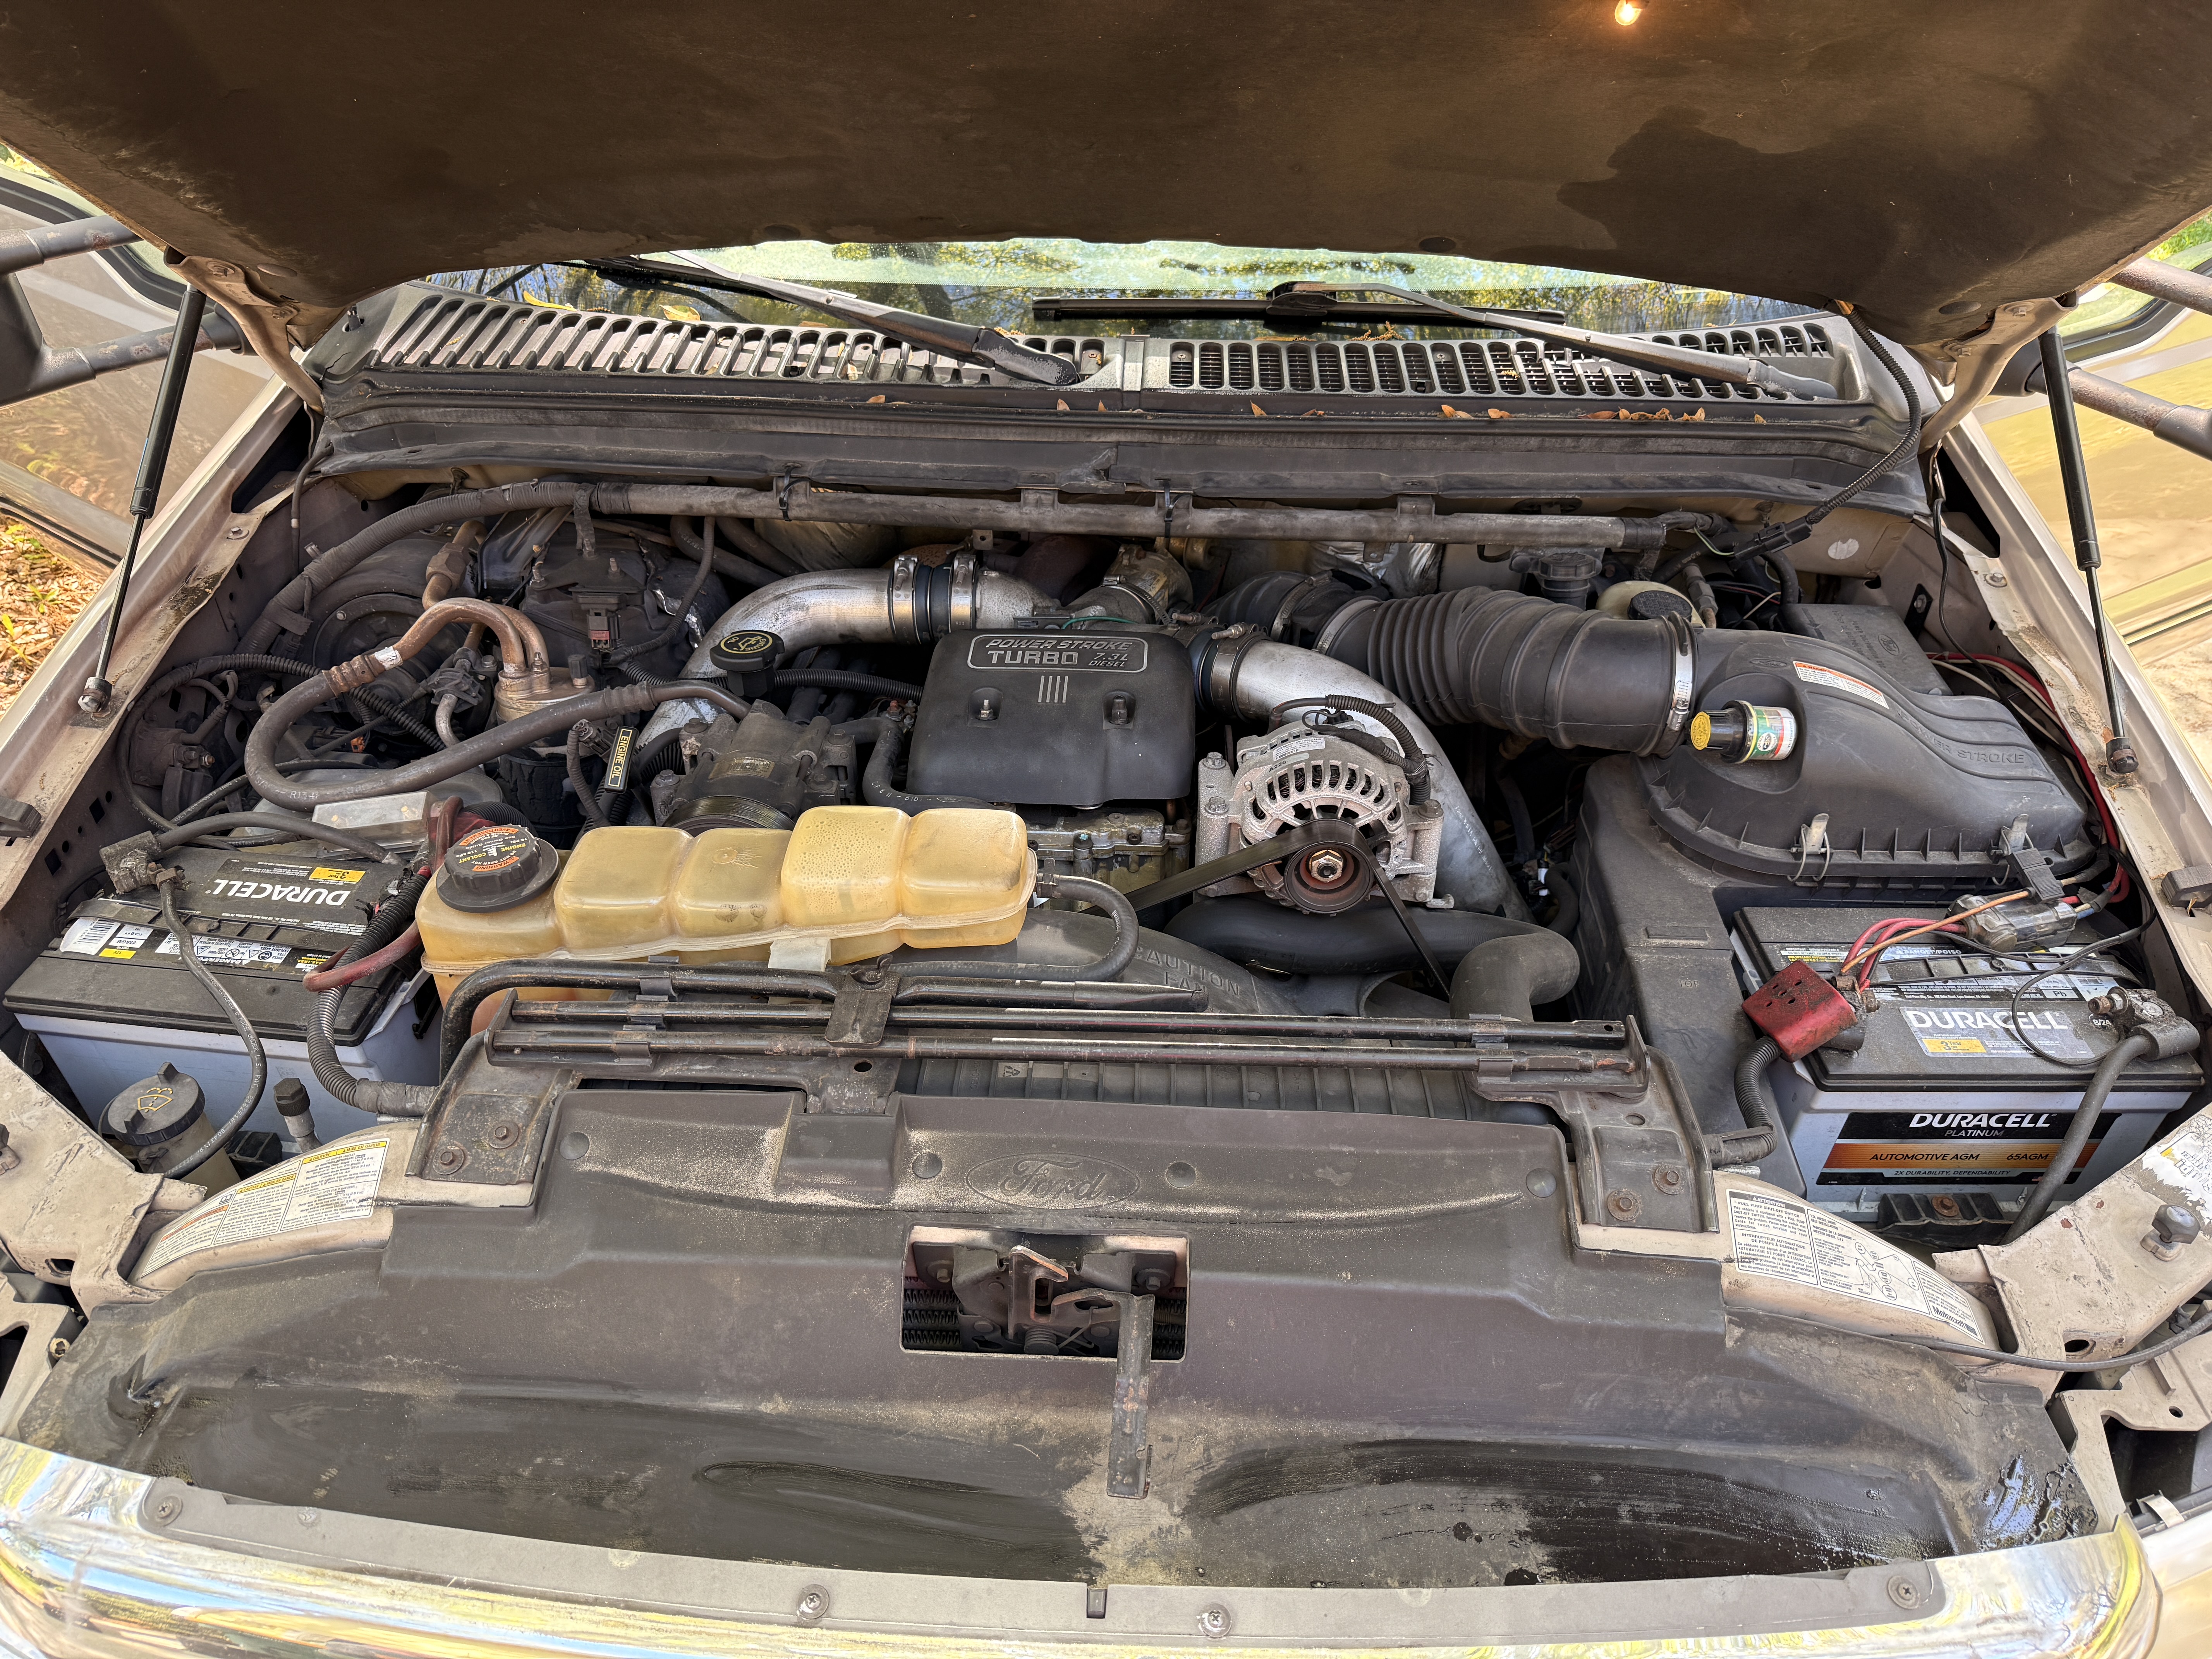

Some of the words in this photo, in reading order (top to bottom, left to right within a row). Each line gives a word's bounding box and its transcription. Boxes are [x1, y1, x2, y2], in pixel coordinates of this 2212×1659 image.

[742, 639, 766, 652] ENGINE
[986, 639, 1057, 649] POWER
[1057, 640, 1133, 651] STROKE
[988, 651, 1078, 665] TURBO
[615, 736, 629, 764] ENGINE
[1957, 748, 2026, 764] STROKE
[611, 765, 621, 778] OIL
[1269, 761, 1286, 772] A220
[500, 843, 526, 852] ENGINE
[458, 852, 486, 863] COOLANT
[476, 860, 508, 869] WARNING
[340, 870, 350, 879] 3
[211, 878, 351, 907] DURACELL
[1906, 1011, 2068, 1029] DURACELL
[247, 1033, 259, 1052] UNDER
[1941, 1041, 1951, 1050] 3
[252, 1074, 260, 1088] PAT.
[1909, 1114, 2051, 1127] DURACELL
[999, 1159, 1108, 1200] Ford
[1741, 1233, 1775, 1242] INTERRUPTEUR
[1776, 1239, 1806, 1249] AUTOMATIQUE
[1932, 1305, 1964, 1328] Motorcraft
